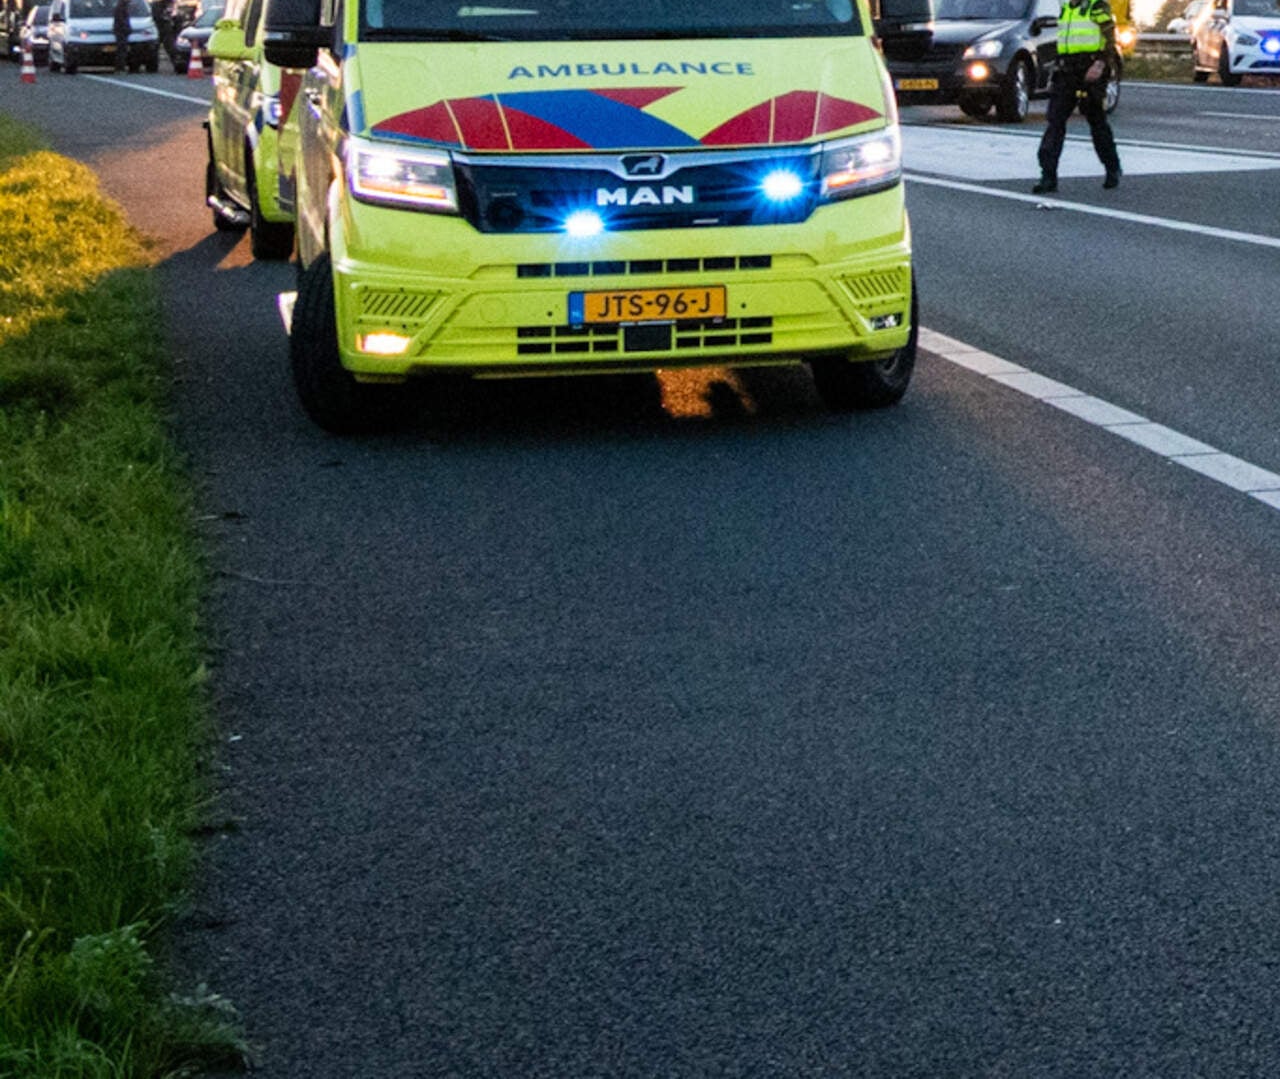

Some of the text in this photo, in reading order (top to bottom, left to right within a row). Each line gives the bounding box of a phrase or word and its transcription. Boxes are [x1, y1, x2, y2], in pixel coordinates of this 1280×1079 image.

[507, 62, 756, 79] AMBULANCE
[596, 185, 693, 206] MAN
[598, 291, 711, 318] JTS-96-J
